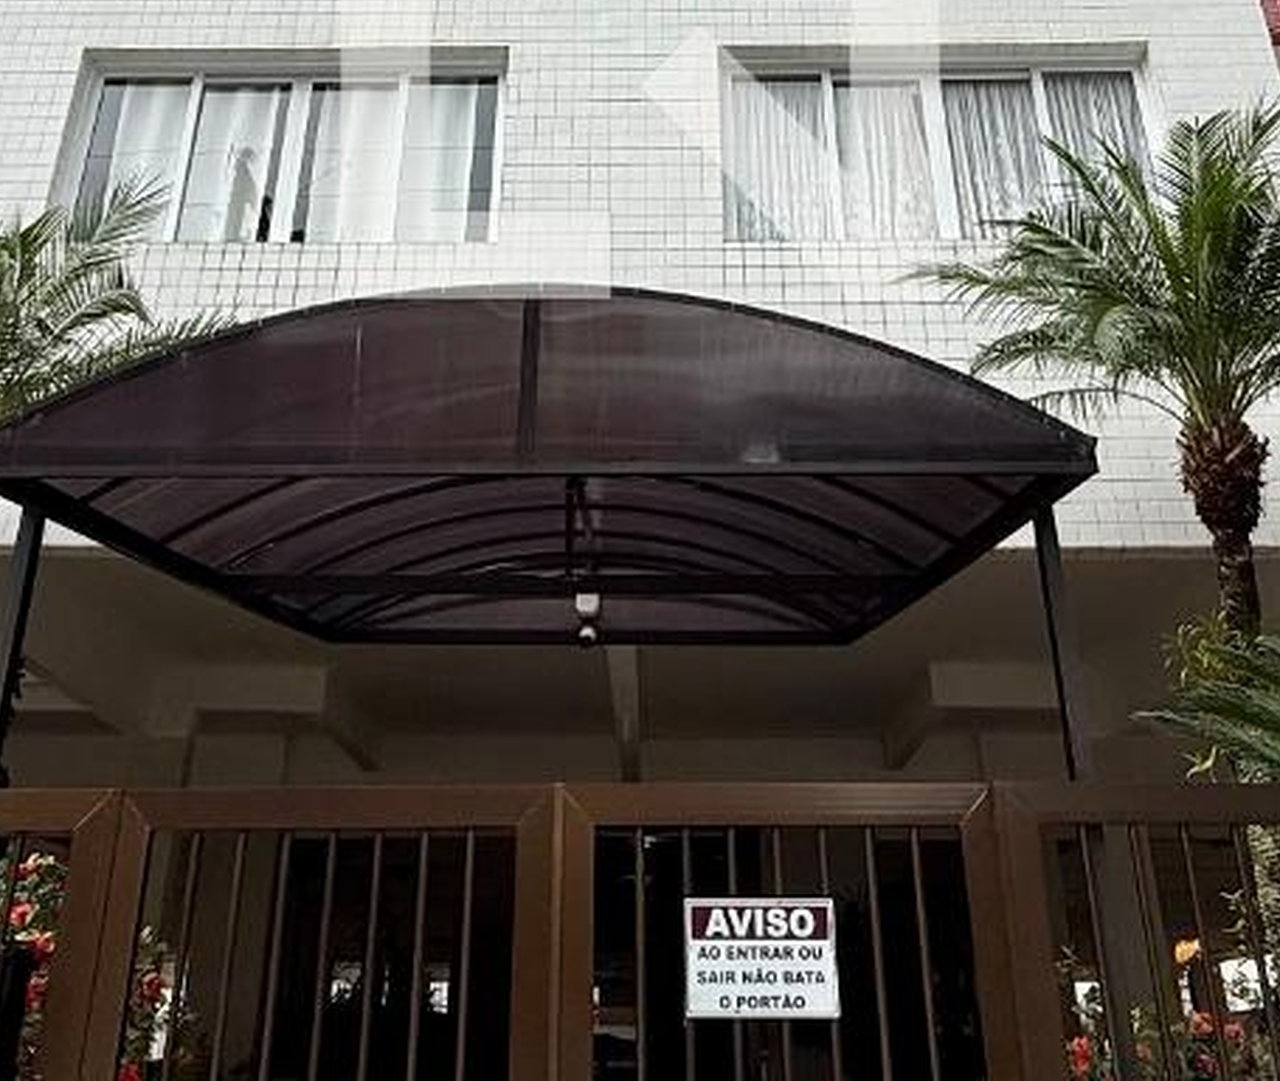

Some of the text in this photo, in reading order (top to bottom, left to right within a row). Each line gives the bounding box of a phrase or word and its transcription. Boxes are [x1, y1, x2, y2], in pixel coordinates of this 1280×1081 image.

[705, 908, 815, 938] AVISO
[697, 945, 823, 960] AO ENTRAR OU
[696, 968, 826, 985] SAIR NÃO BATA
[719, 994, 806, 1009] O PORTÃO
